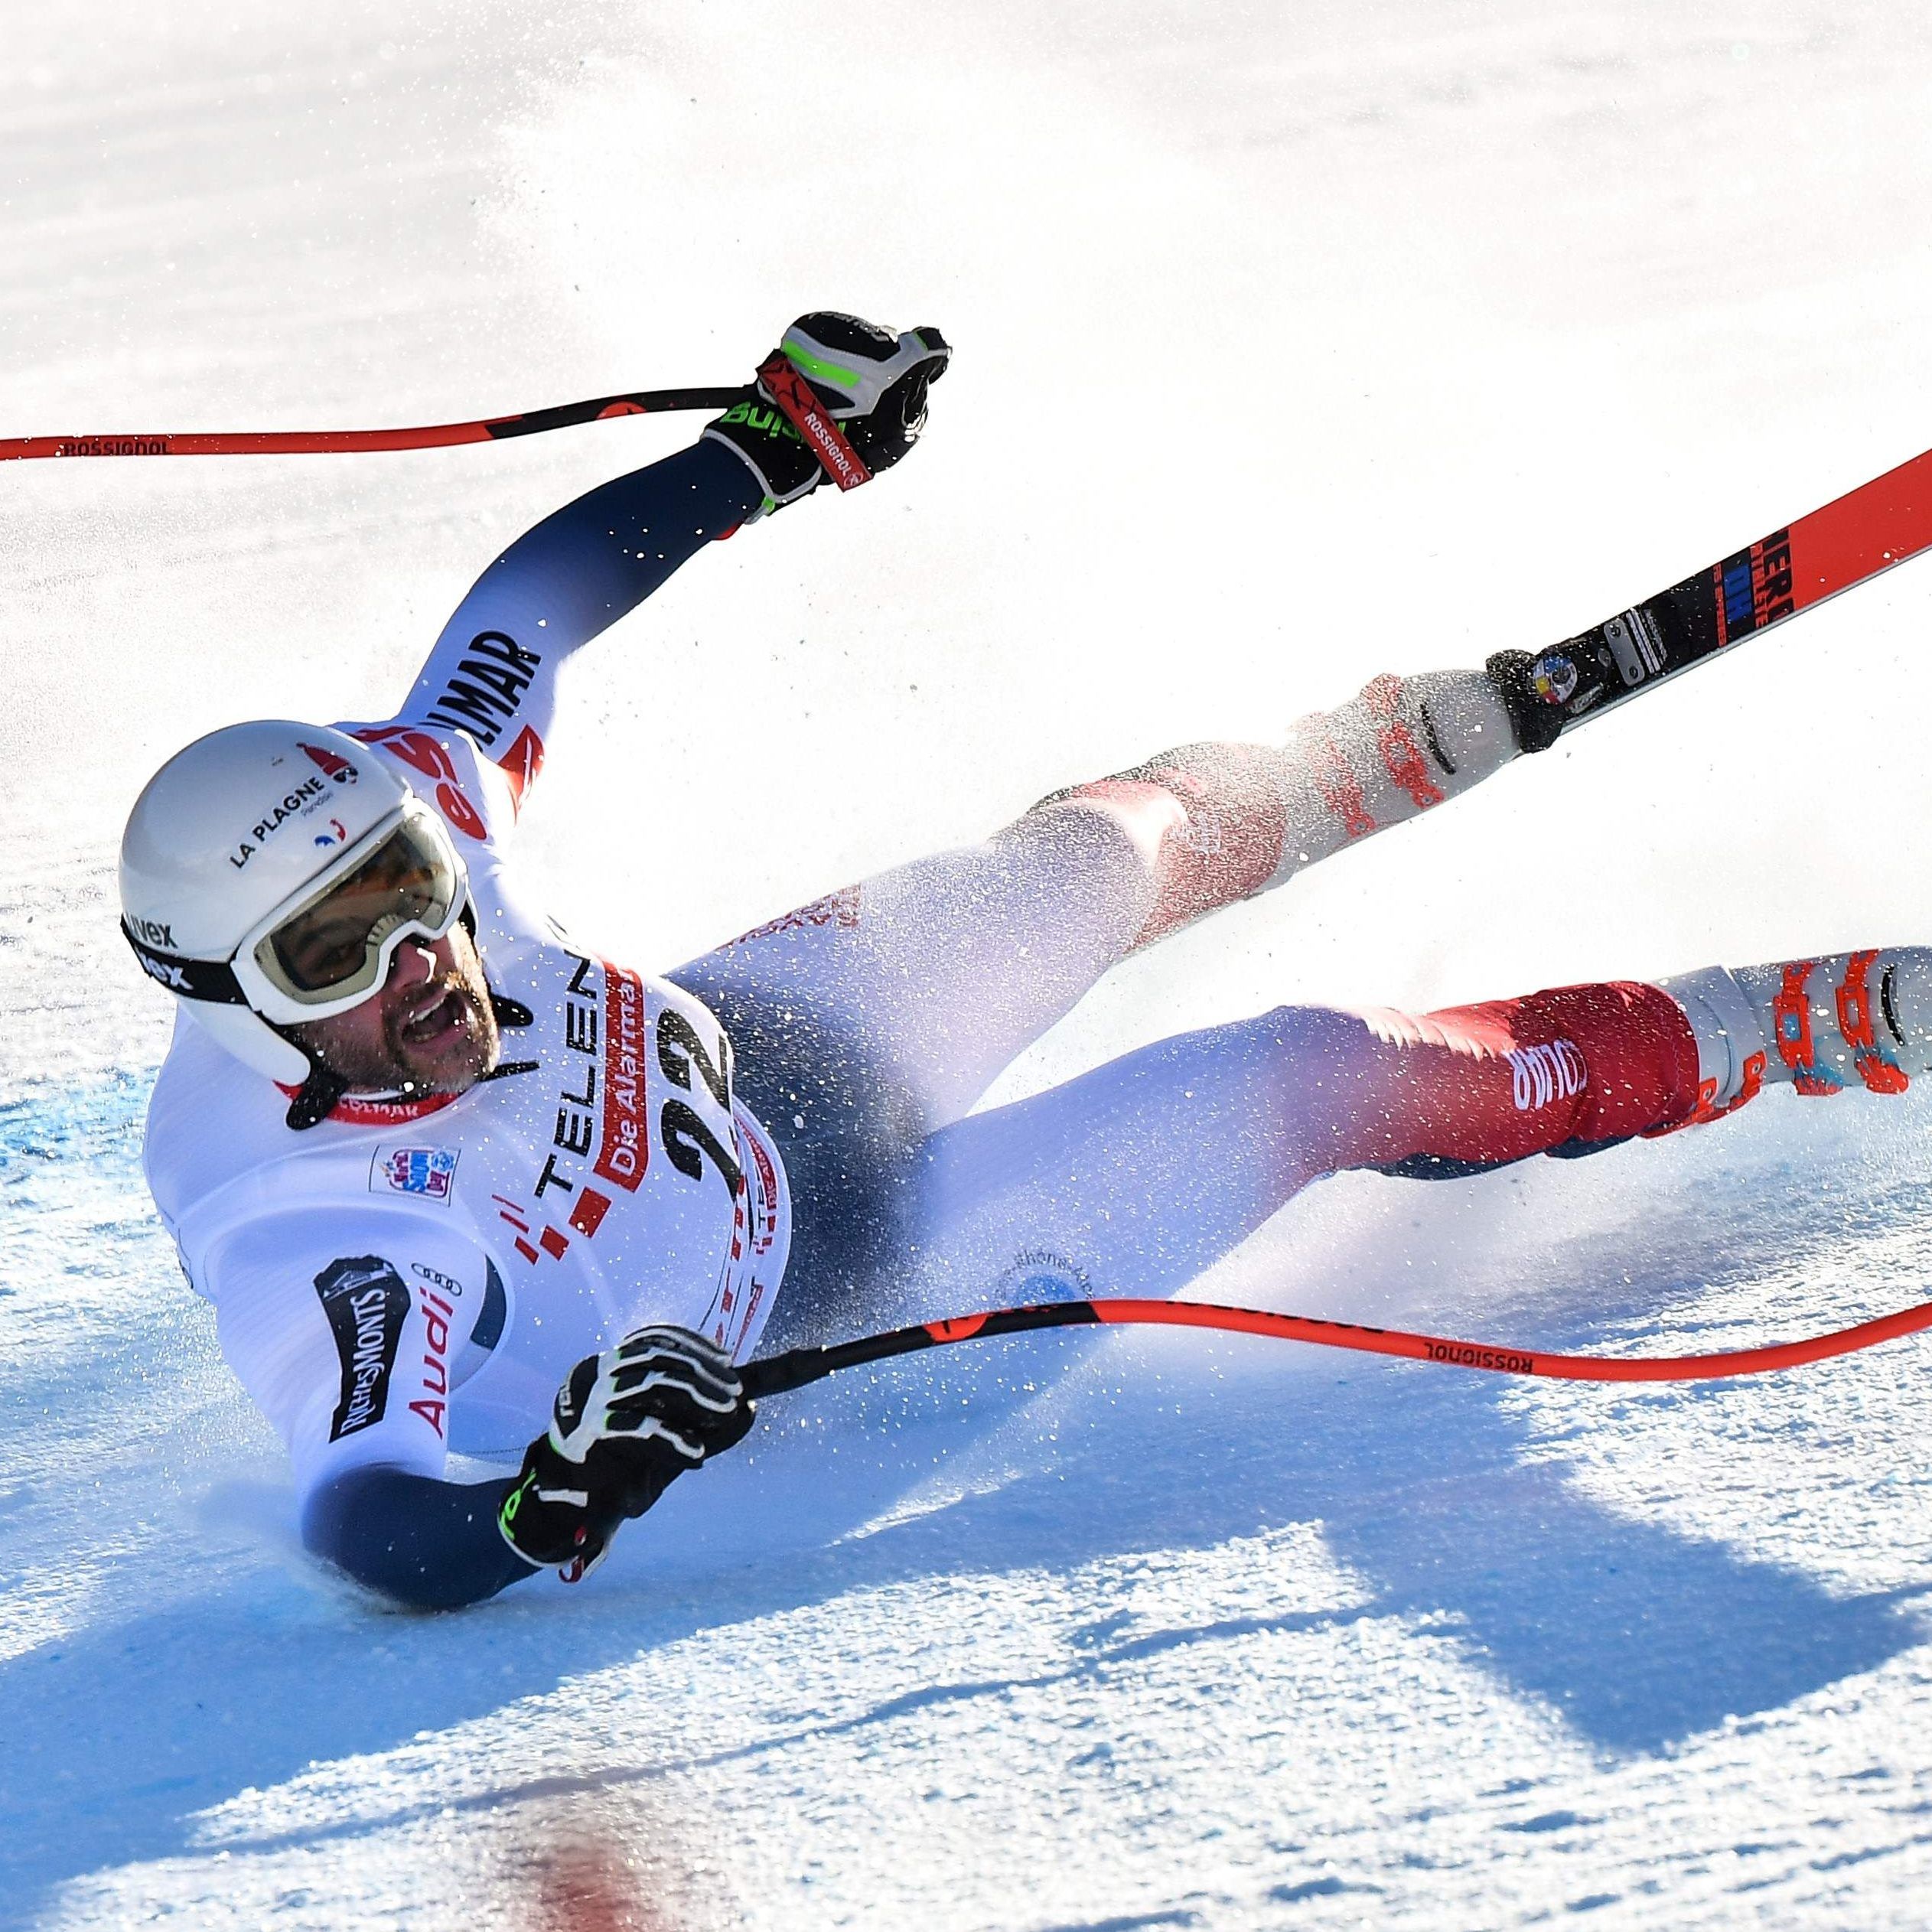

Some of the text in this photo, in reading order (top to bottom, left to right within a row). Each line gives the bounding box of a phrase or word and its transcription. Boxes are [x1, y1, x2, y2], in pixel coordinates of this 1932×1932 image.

[64, 441, 168, 457] ROSSIGNOL
[804, 412, 852, 476] ROSSIGNOL
[419, 630, 542, 753] LMAR
[230, 777, 324, 868] LA PLAGNE
[533, 948, 598, 1199] TELEN
[656, 1007, 744, 1207] 22
[1505, 1039, 1588, 1111] COLMAR
[609, 1119, 638, 1177] Die
[408, 1286, 454, 1440] Audi
[1425, 1341, 1533, 1374] ROSSIGNOL
